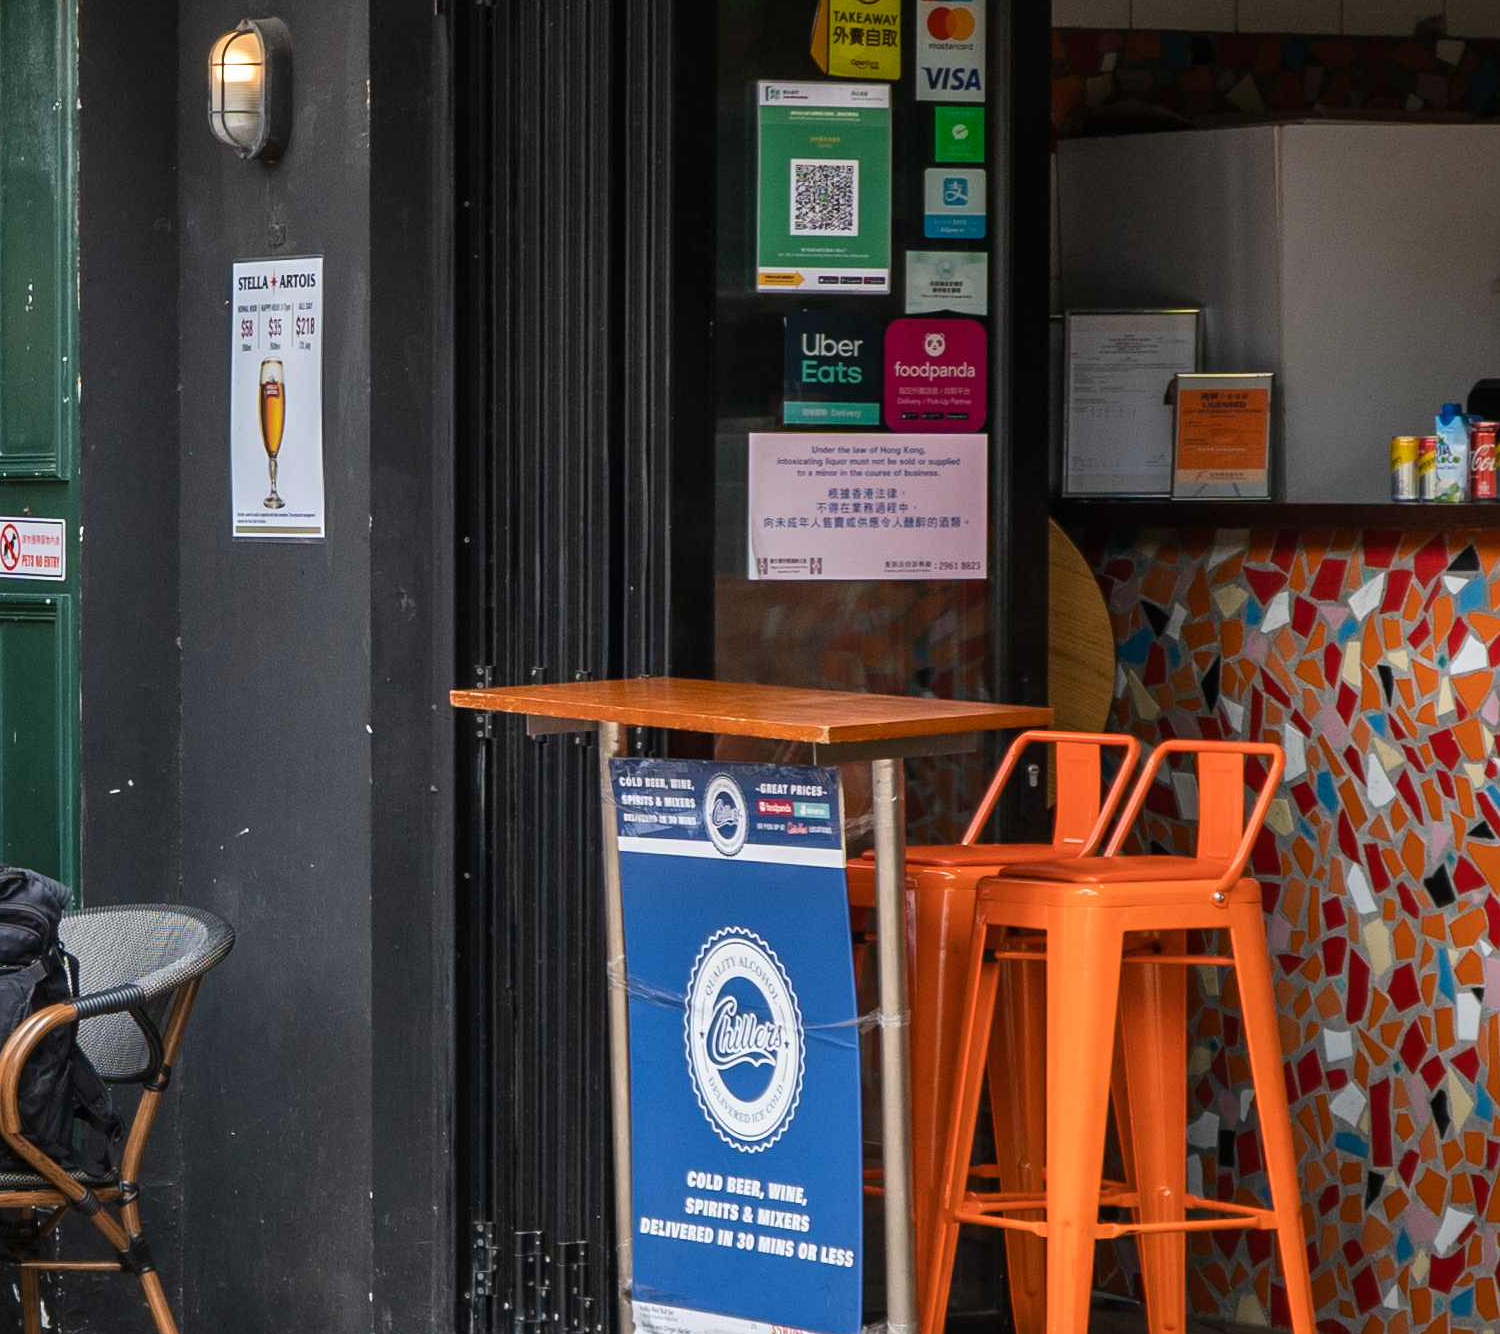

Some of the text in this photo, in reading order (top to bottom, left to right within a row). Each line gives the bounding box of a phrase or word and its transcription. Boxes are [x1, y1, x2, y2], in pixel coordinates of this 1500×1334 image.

[833, 10, 899, 26] TAKEAWAY
[833, 26, 899, 48] 外賣自取
[928, 41, 974, 51] mastercard
[921, 66, 982, 91] VISA
[238, 273, 316, 291] STELLA ARTOIS
[268, 317, 283, 338] $35
[802, 333, 863, 357] Uber
[802, 360, 863, 384] Eats
[894, 362, 976, 381] foodpanda
[812, 445, 927, 456] Under the law of Hong Kong,
[777, 457, 961, 468] intoxicating liquor must not be sold or supplied
[21, 554, 60, 568] PETS NO ENTRY
[706, 995, 784, 1070] Chillers
[687, 1171, 808, 1207] COLD BEER, WINE,
[685, 1198, 810, 1234] SPIRITS & MIXERS
[640, 1217, 854, 1269] DELIVERED IN 30 MINS OR LESS
